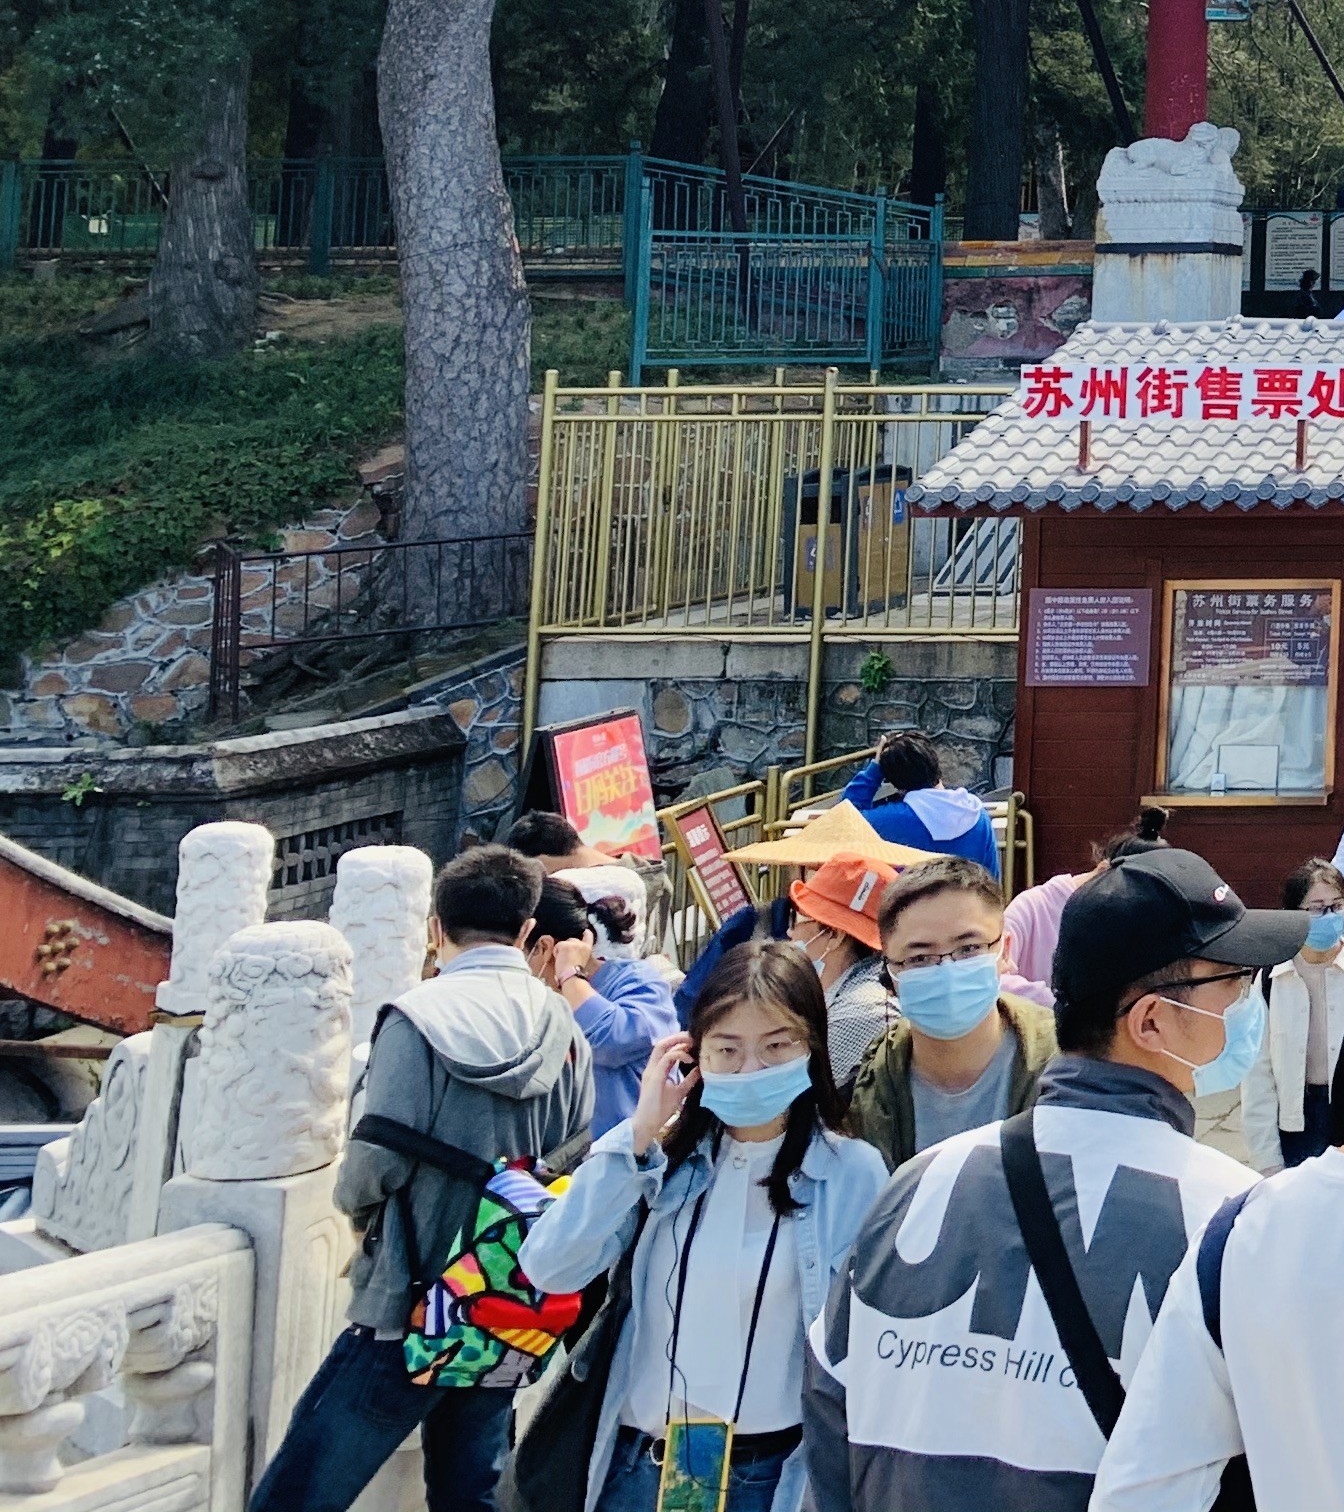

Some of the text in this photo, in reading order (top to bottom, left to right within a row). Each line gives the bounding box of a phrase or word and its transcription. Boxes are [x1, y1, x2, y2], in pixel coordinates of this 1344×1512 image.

[1192, 593, 1314, 608] 苏州街票务服务
[877, 1329, 996, 1372] Cypress
[1004, 1347, 1055, 1382] Hill
